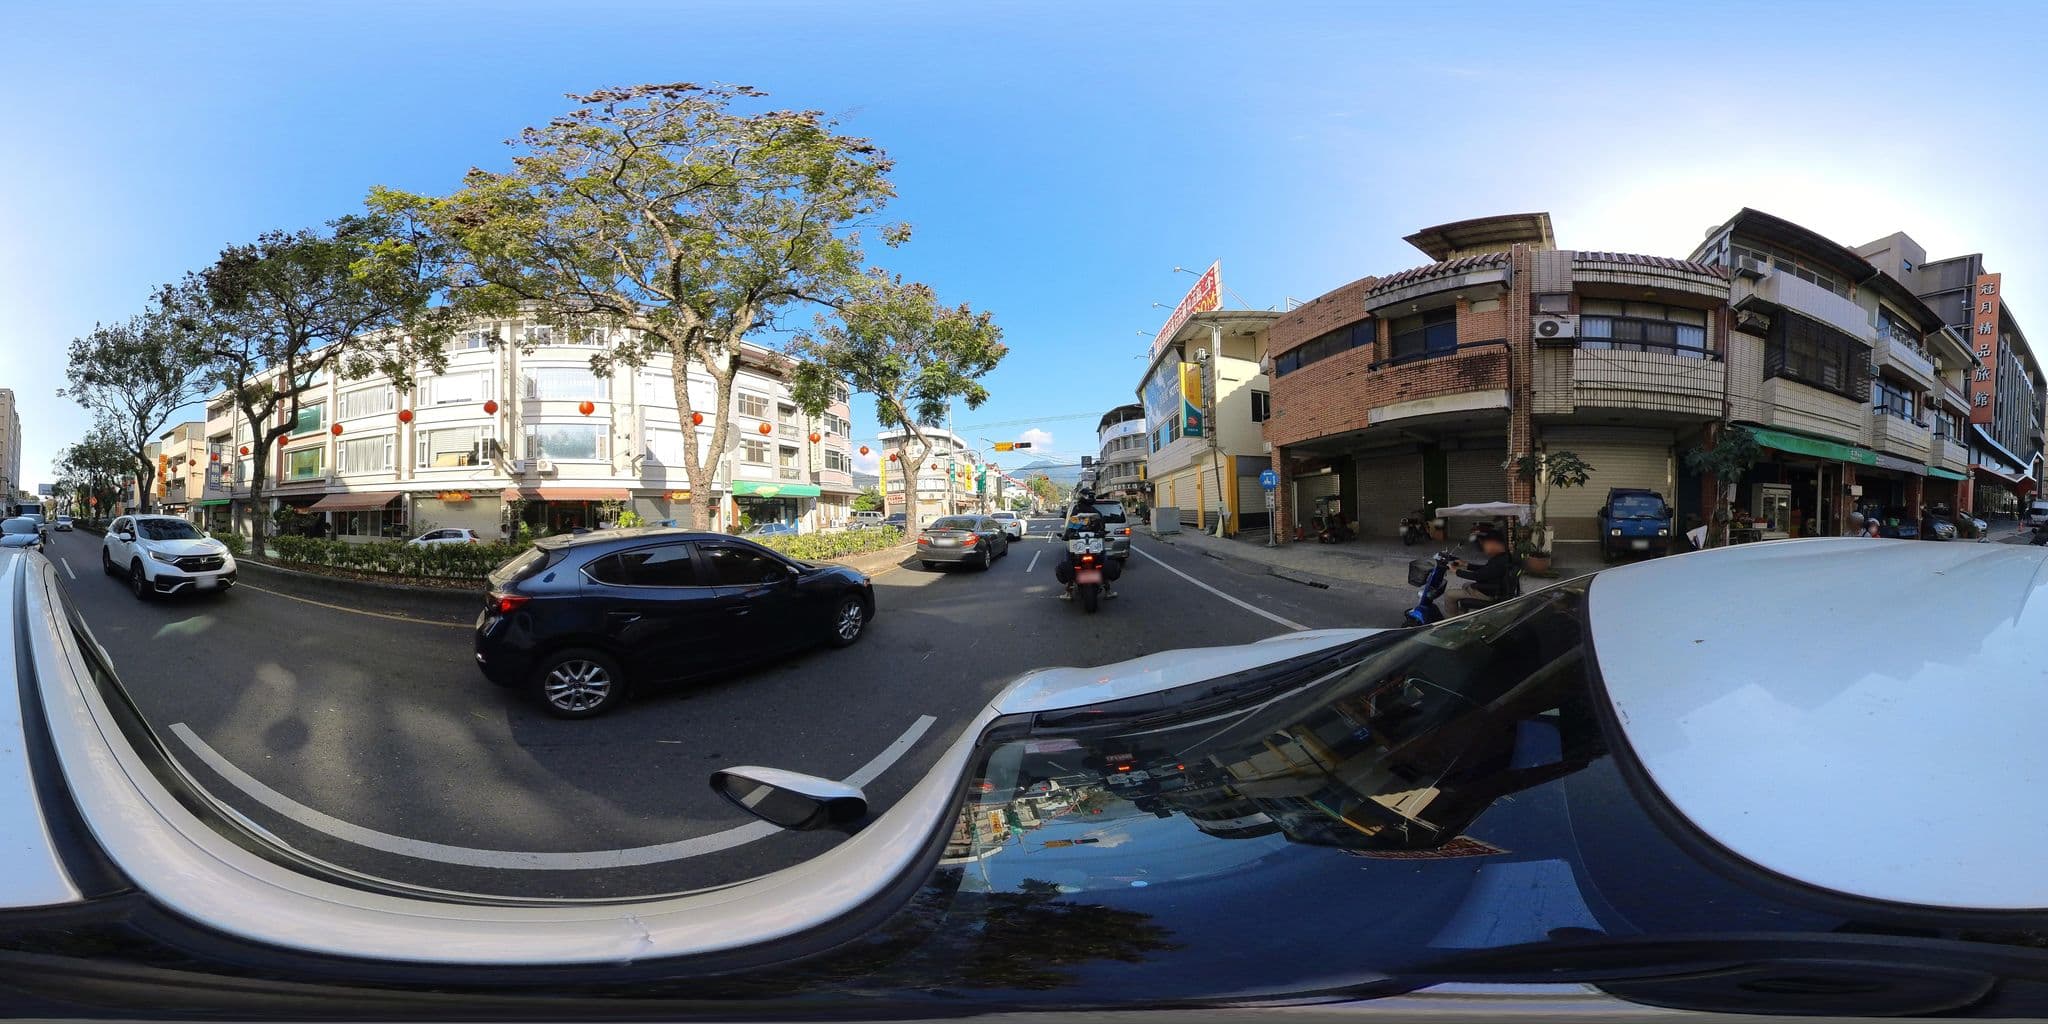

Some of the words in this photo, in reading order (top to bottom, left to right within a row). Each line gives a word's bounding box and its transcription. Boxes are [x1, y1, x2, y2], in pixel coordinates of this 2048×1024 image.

[1975, 283, 1995, 407] 冠月精品旅館
